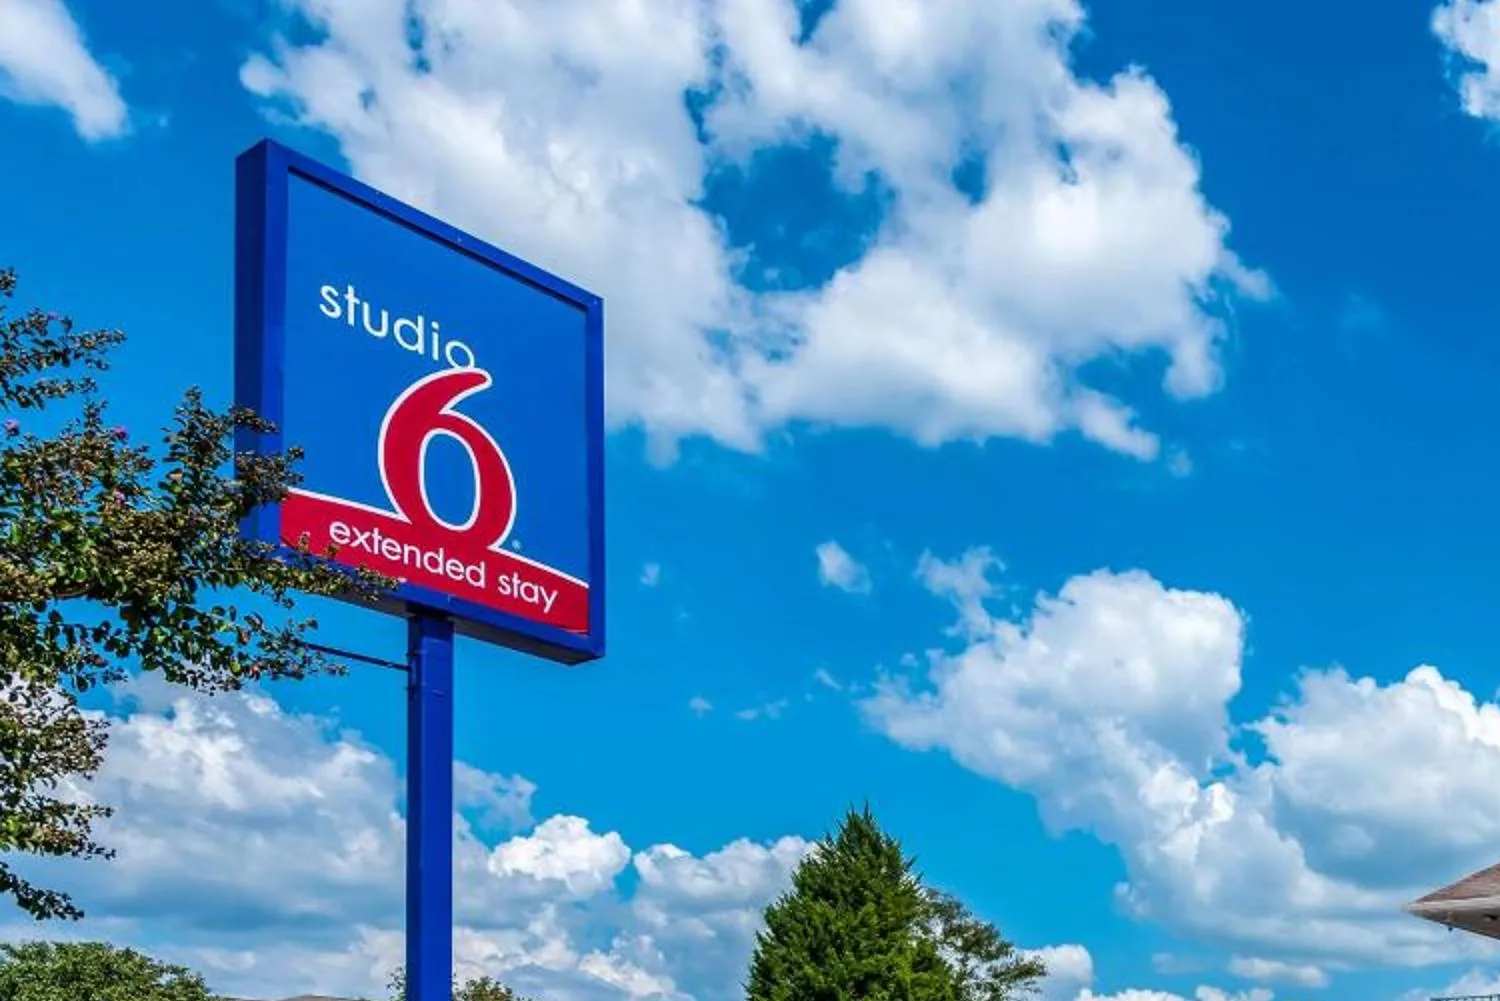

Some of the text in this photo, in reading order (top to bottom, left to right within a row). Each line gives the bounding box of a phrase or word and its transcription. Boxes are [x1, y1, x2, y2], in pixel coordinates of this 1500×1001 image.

[319, 284, 475, 369] studio
[378, 366, 517, 551] 6
[329, 521, 558, 613] extended stay
